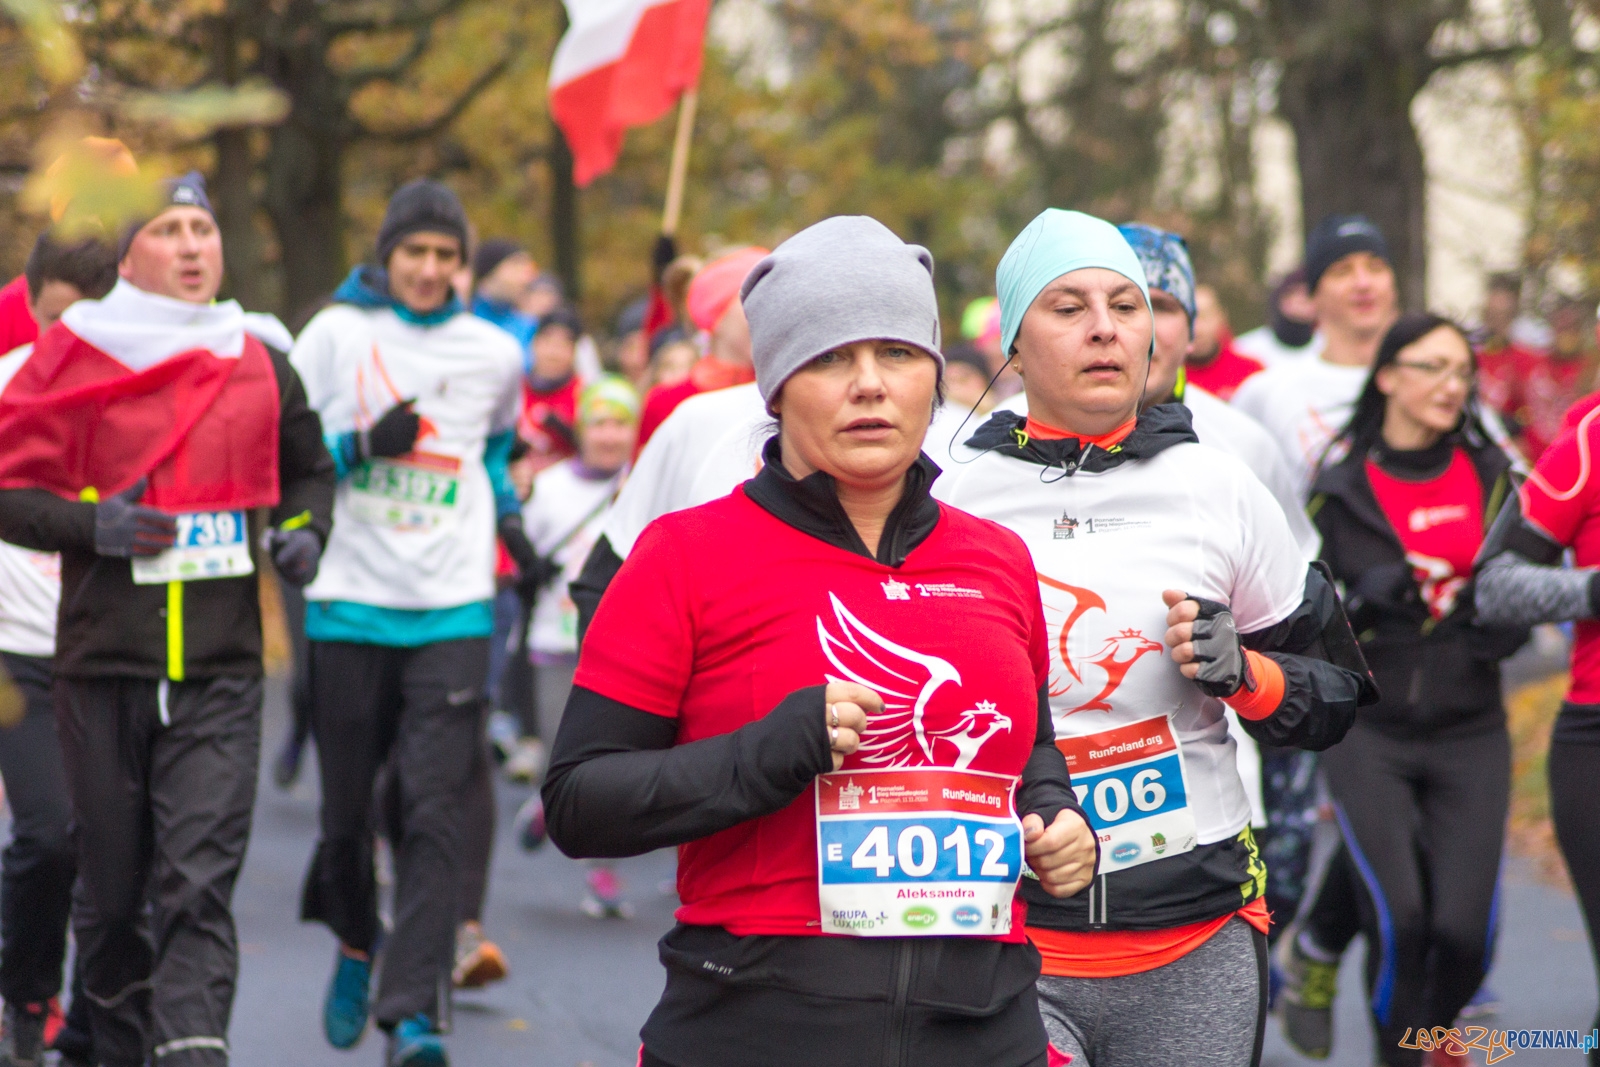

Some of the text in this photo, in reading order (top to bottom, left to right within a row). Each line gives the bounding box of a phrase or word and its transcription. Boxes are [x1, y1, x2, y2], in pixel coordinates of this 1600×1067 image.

[1085, 518, 1096, 534] 1
[1089, 734, 1163, 760] RunPoland.org
[868, 785, 879, 804] 1
[942, 788, 1001, 808] RunPoland.org
[827, 843, 843, 862] E
[851, 825, 1009, 877] 4012
[896, 888, 975, 899] Aleksandra
[832, 910, 867, 919] GRUPA
[833, 919, 874, 929] LUXMED
